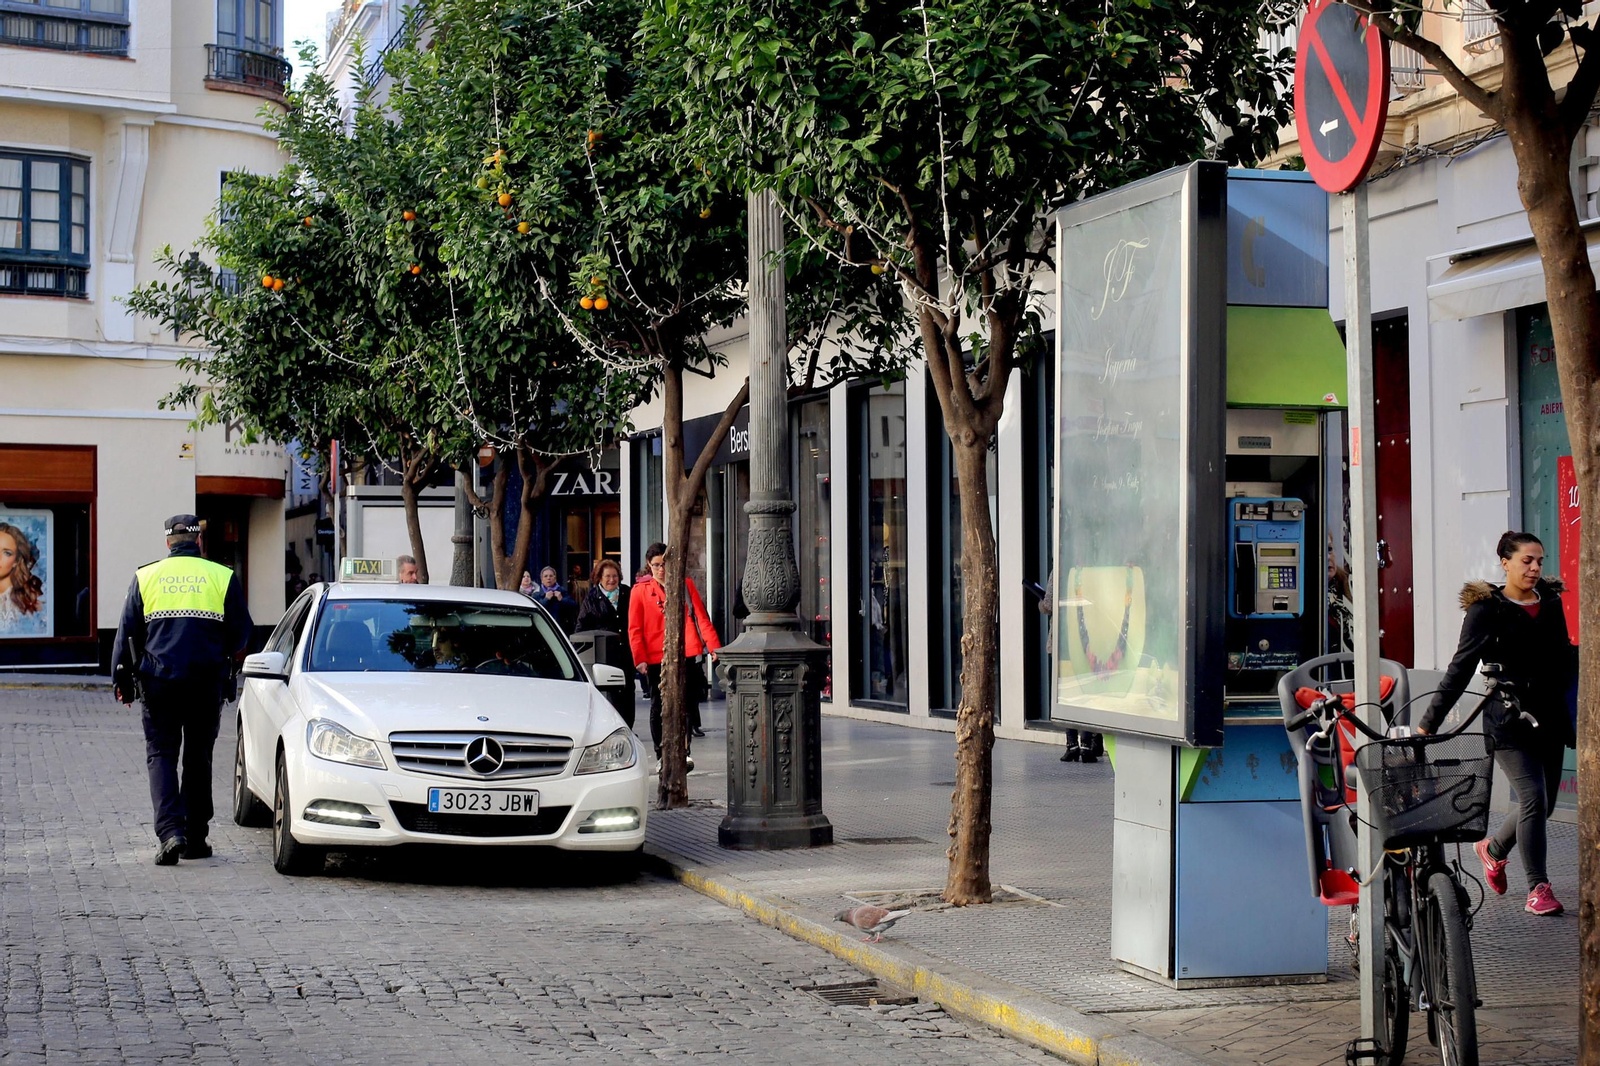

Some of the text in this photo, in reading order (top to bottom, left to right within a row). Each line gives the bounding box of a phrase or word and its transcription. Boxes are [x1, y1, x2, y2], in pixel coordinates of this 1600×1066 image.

[225, 448, 254, 456] MAKE
[301, 457, 311, 490] MAN
[550, 471, 620, 496] ZAR
[354, 560, 381, 574] TAXI
[159, 576, 207, 584] POLICIA
[163, 585, 202, 594] LOCAL
[443, 792, 533, 812] 3023 JBW
